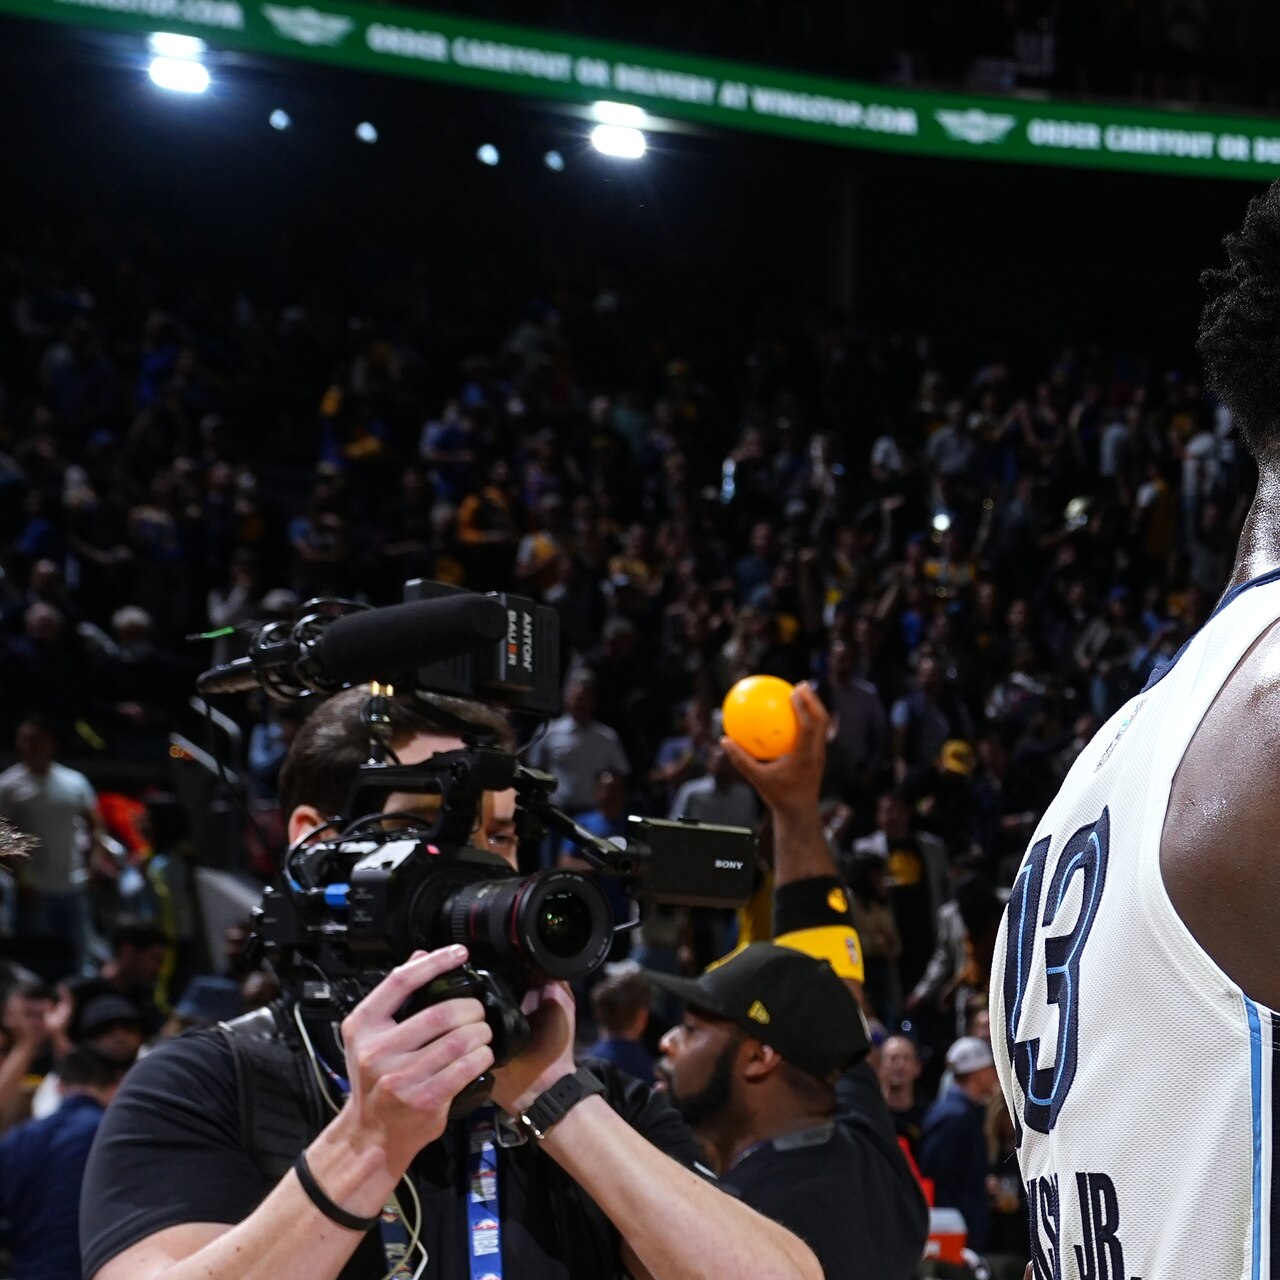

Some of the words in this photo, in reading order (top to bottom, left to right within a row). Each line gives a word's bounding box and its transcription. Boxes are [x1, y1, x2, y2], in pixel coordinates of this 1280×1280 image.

[366, 22, 448, 62] ORDER
[573, 56, 610, 89] OR
[718, 79, 750, 112] AT
[1026, 118, 1100, 150] ORDER
[1217, 132, 1251, 163] OR
[522, 610, 533, 670] ANTON
[714, 859, 744, 870] SONY
